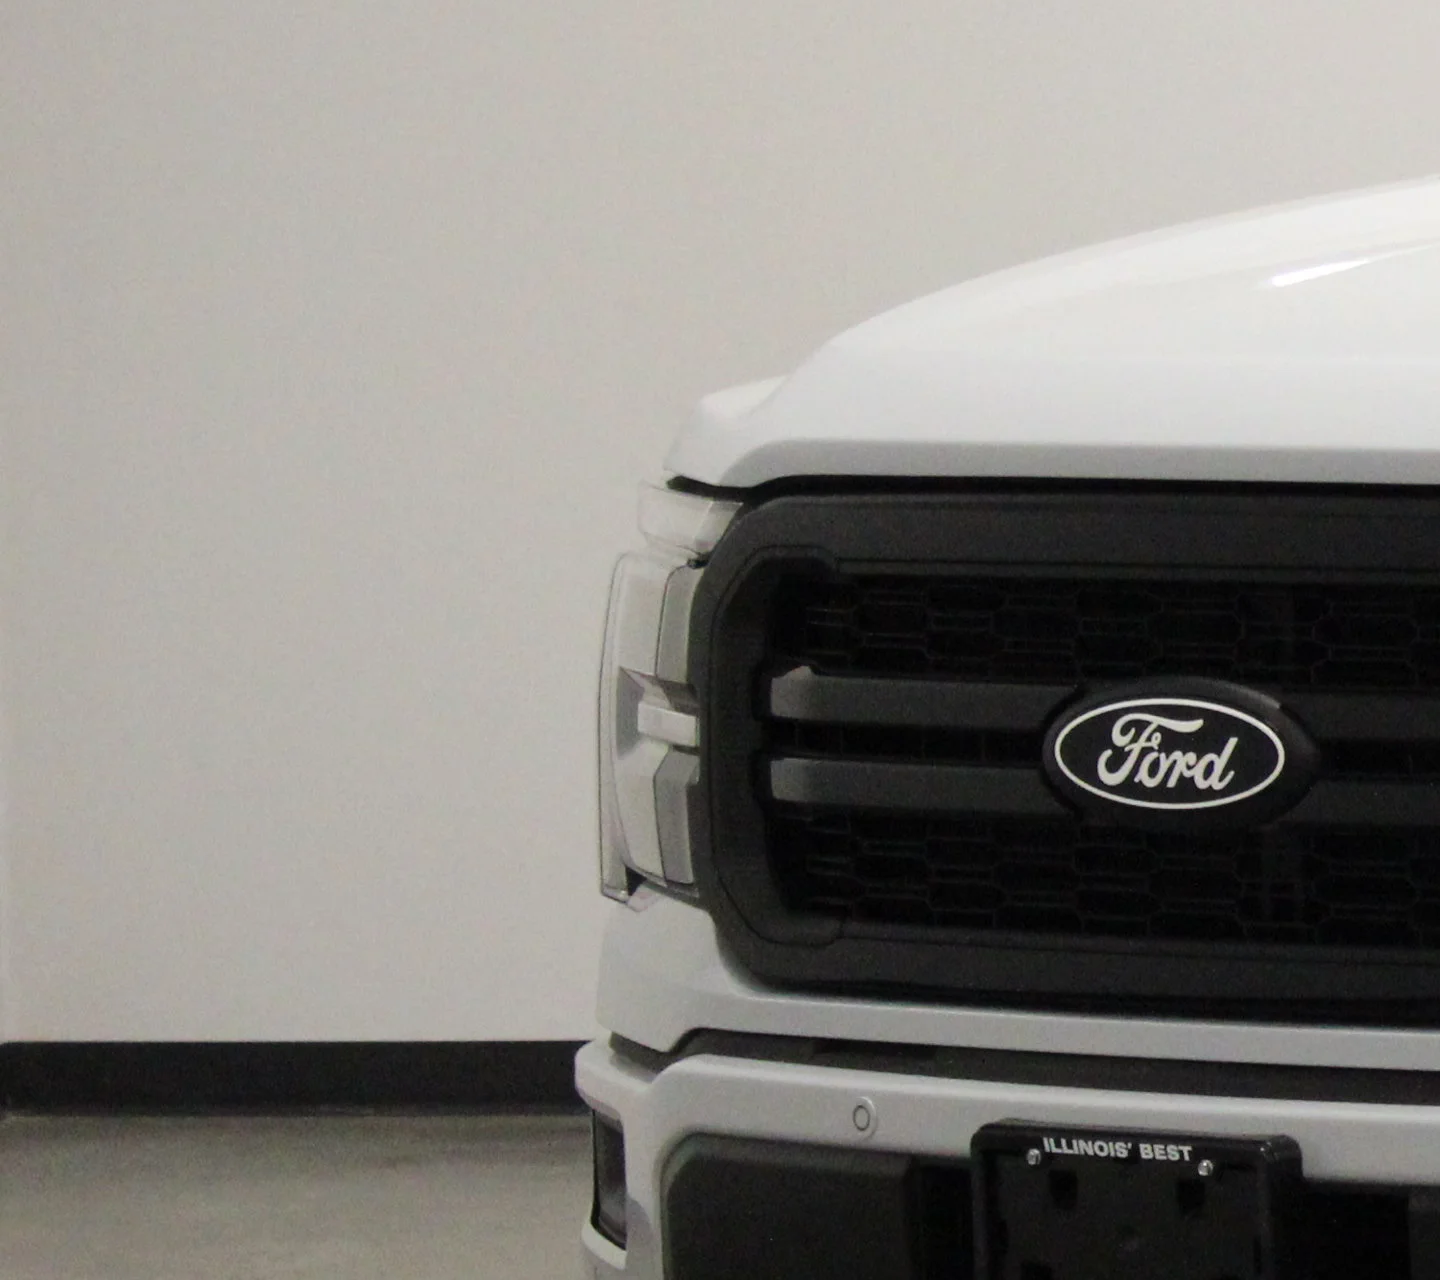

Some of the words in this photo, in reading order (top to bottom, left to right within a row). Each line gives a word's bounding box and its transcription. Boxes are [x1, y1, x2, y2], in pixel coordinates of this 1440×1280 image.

[1097, 713, 1239, 790] Ford
[1042, 1136, 1132, 1158] ILLINOIS'
[1139, 1142, 1193, 1161] BEST
